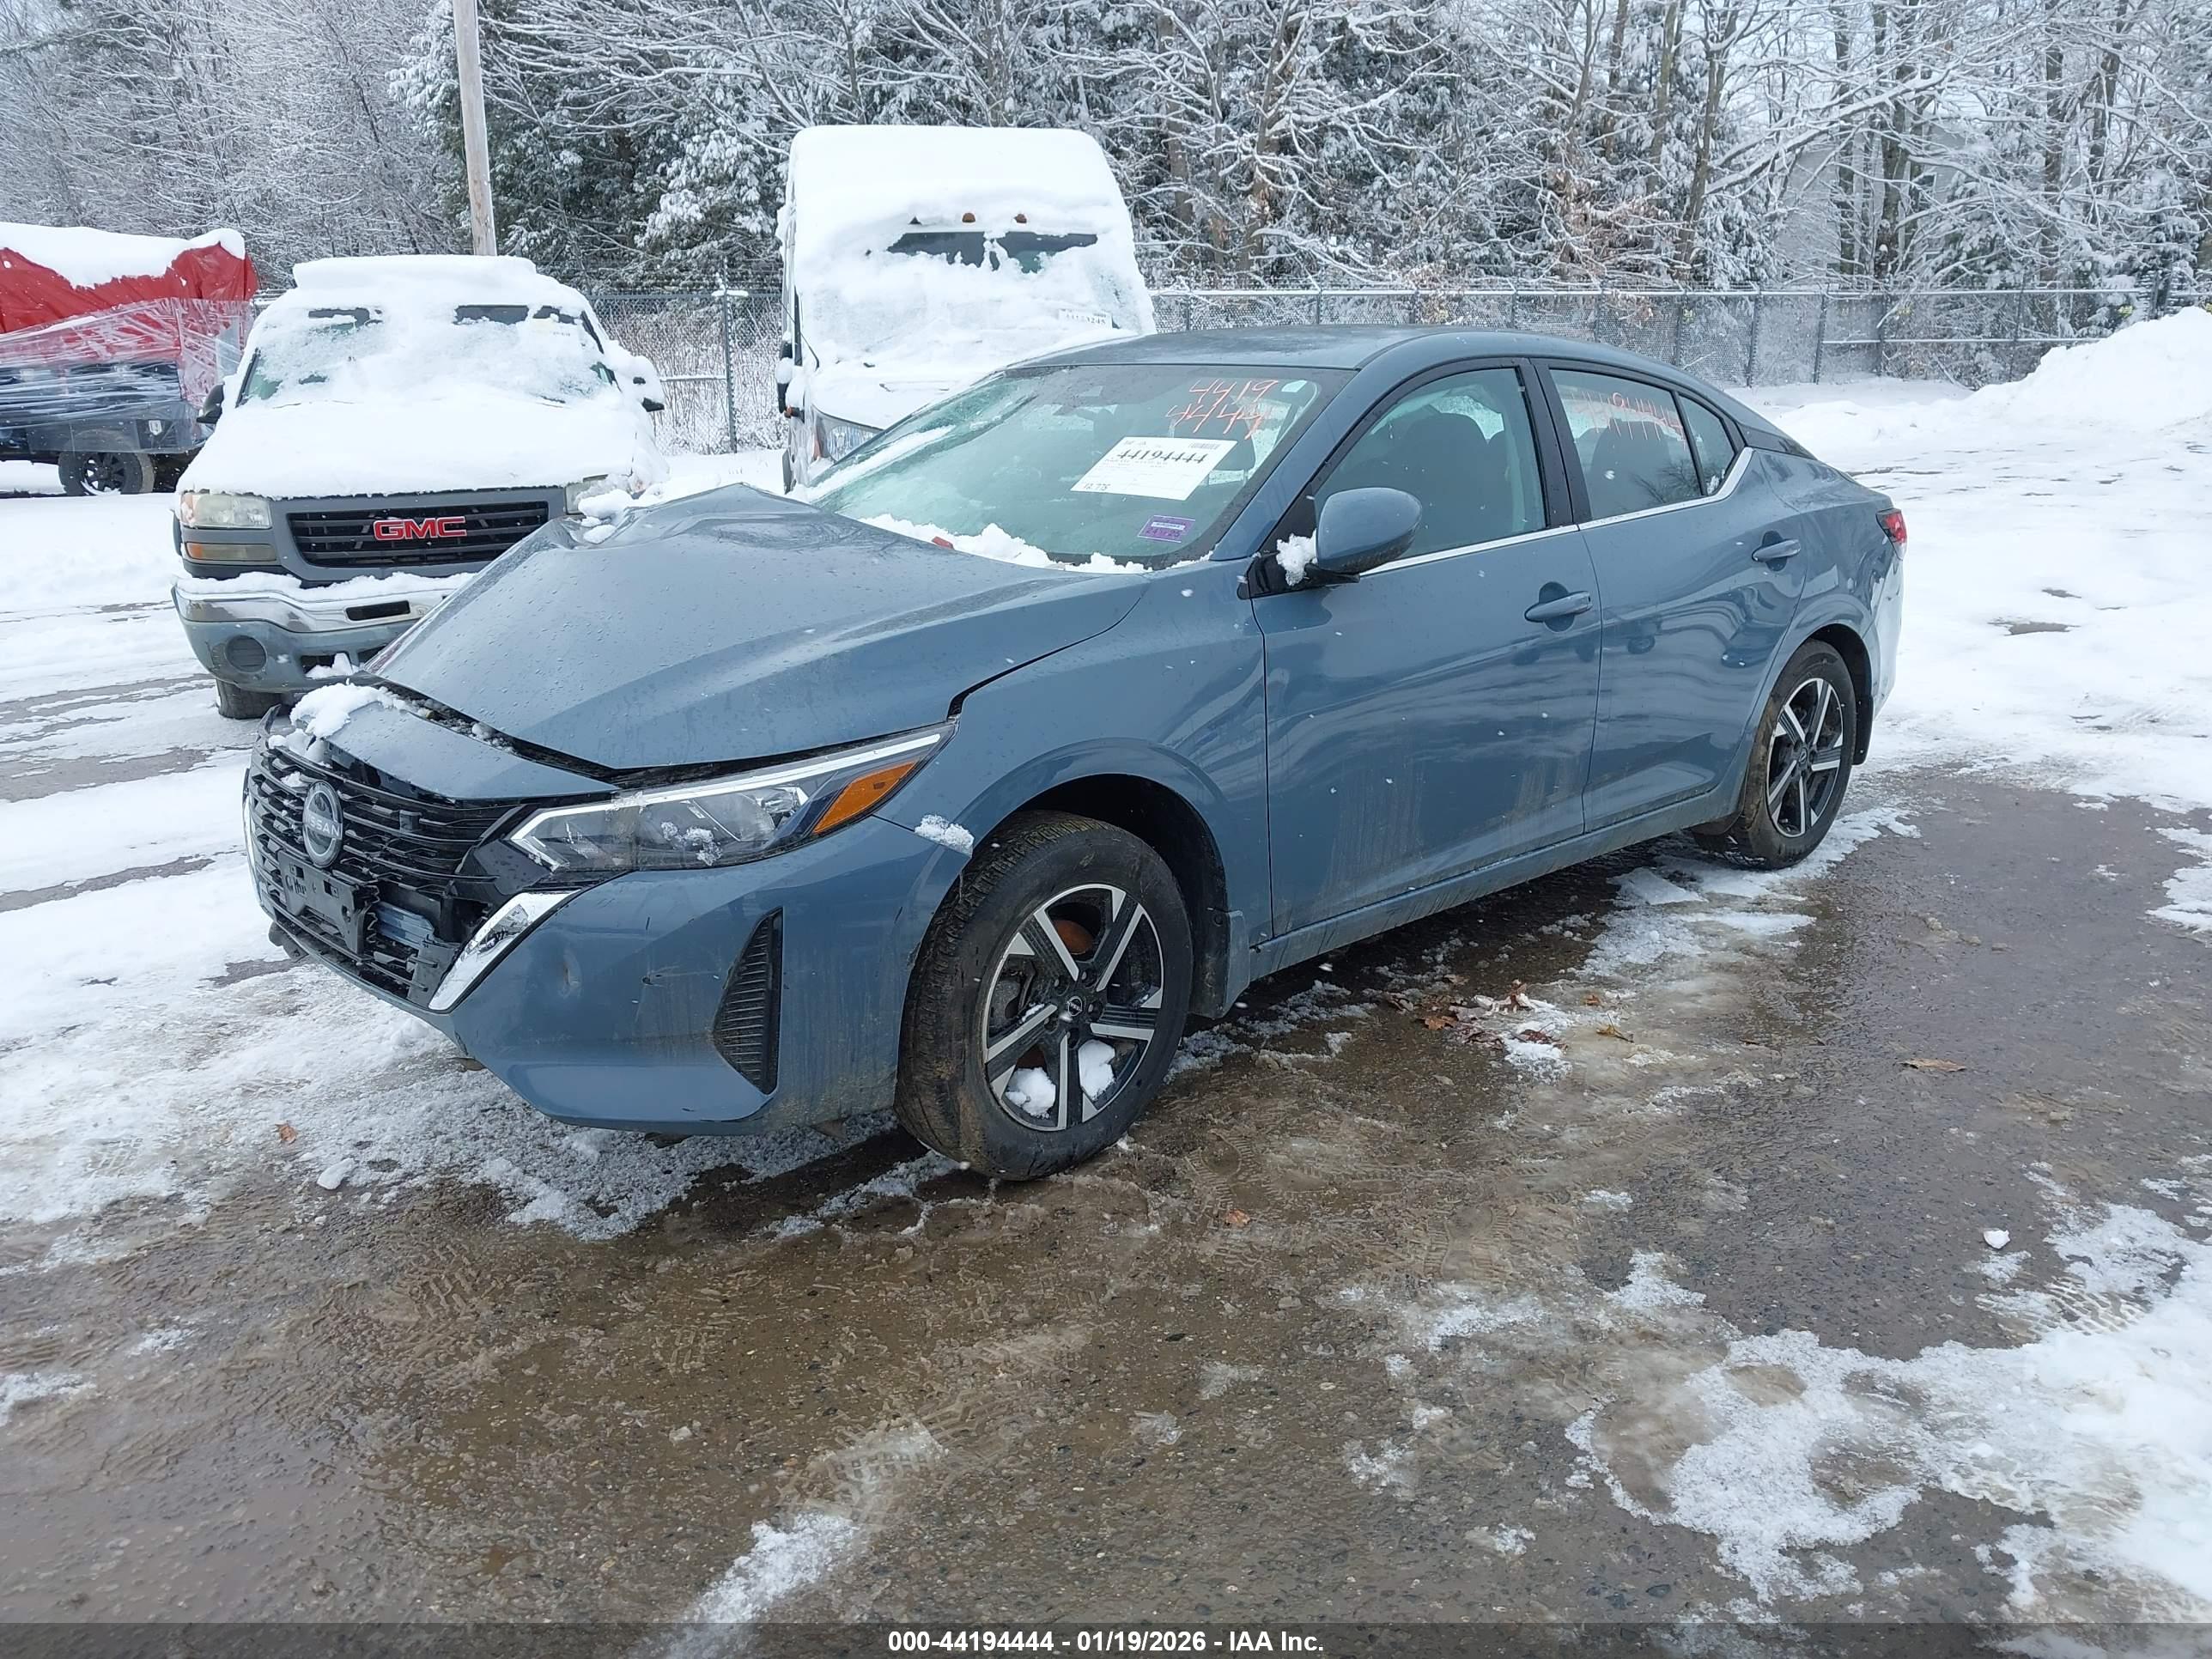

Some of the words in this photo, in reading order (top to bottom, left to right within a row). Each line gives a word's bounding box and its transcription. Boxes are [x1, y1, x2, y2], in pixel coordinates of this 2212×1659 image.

[1117, 448, 1208, 465] 44194444
[374, 516, 467, 541] GMC
[305, 813, 340, 837] SSAN
